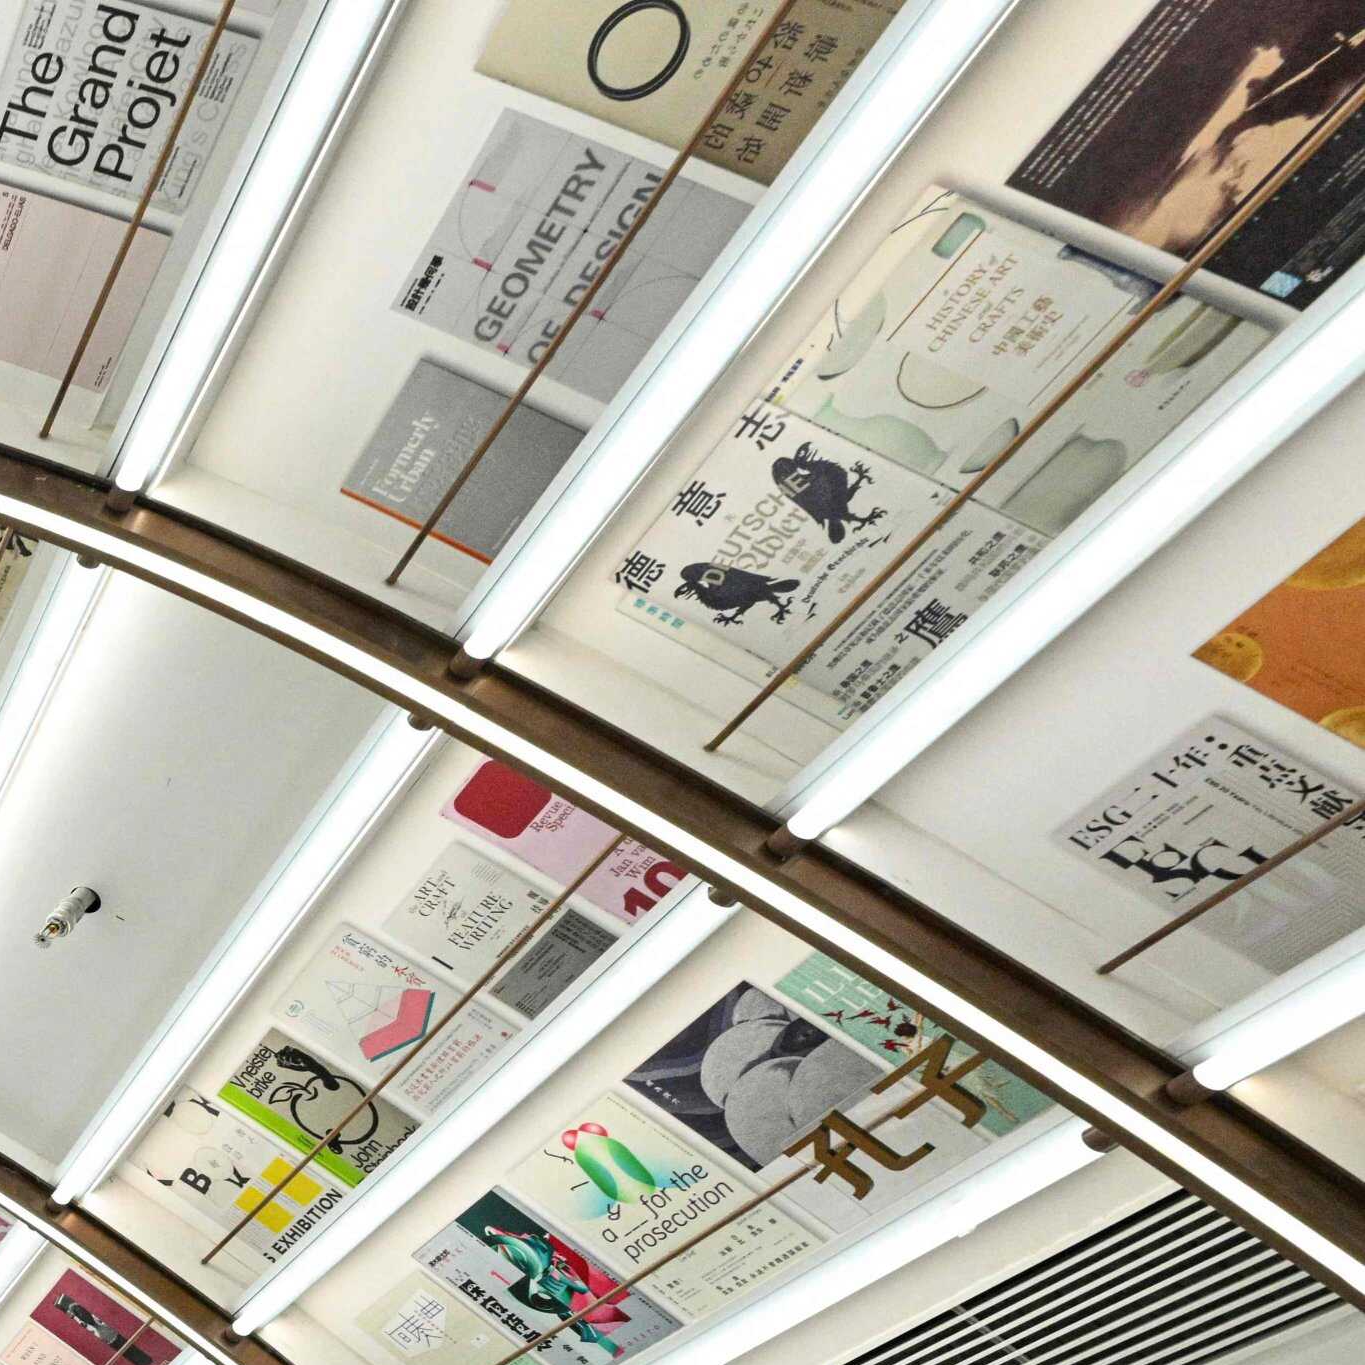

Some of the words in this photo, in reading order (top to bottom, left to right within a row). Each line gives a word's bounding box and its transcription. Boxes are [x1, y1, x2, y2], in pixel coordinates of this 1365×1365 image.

[47, 3, 141, 169] Grand
[93, 26, 192, 183] Projet
[473, 146, 607, 345] GEOMETRY
[563, 172, 668, 308] DESIGN
[925, 262, 989, 333] HISTORY
[927, 283, 990, 354] CHINESE
[988, 252, 1020, 289] ART
[968, 286, 1026, 346] CRAFTS
[371, 411, 442, 498] Formerly
[391, 446, 436, 503] Urban
[615, 408, 793, 595] 德意志
[701, 466, 811, 587] DEUTSCHE
[414, 877, 439, 903] ART
[418, 876, 458, 917] CRAFT
[447, 891, 502, 946] FEATURE
[458, 897, 516, 953] WRITING
[249, 1071, 277, 1101] bitke
[783, 1034, 991, 1200] 孔子
[178, 1165, 213, 1196] B
[350, 1139, 385, 1172] John
[639, 1174, 675, 1218] for
[670, 1160, 710, 1194] the
[271, 1187, 344, 1258] EXHIBITION
[622, 1180, 735, 1264] prosecution
